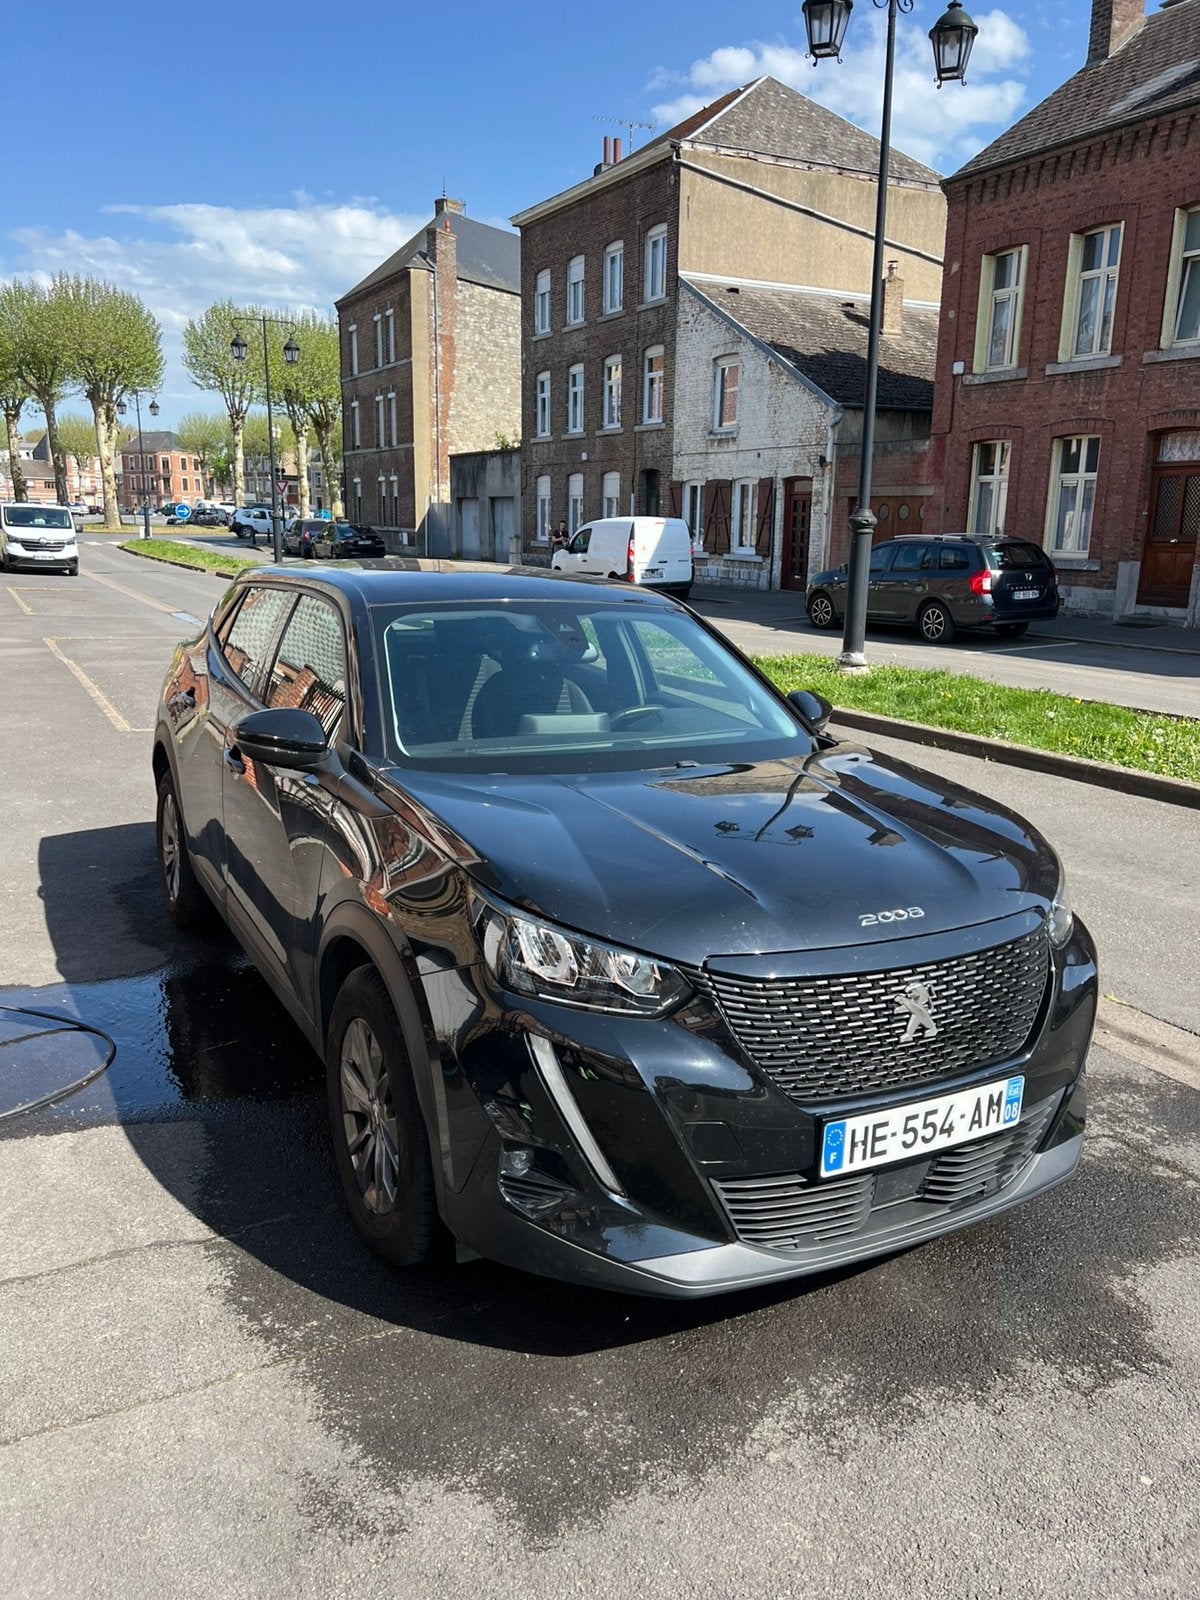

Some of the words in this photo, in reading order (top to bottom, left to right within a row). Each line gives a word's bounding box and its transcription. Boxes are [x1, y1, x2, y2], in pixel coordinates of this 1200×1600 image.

[858, 906, 925, 926] 2008
[1004, 1101, 1019, 1121] 08
[849, 1090, 1003, 1164] HE-554-AM
[829, 1151, 838, 1164] F
